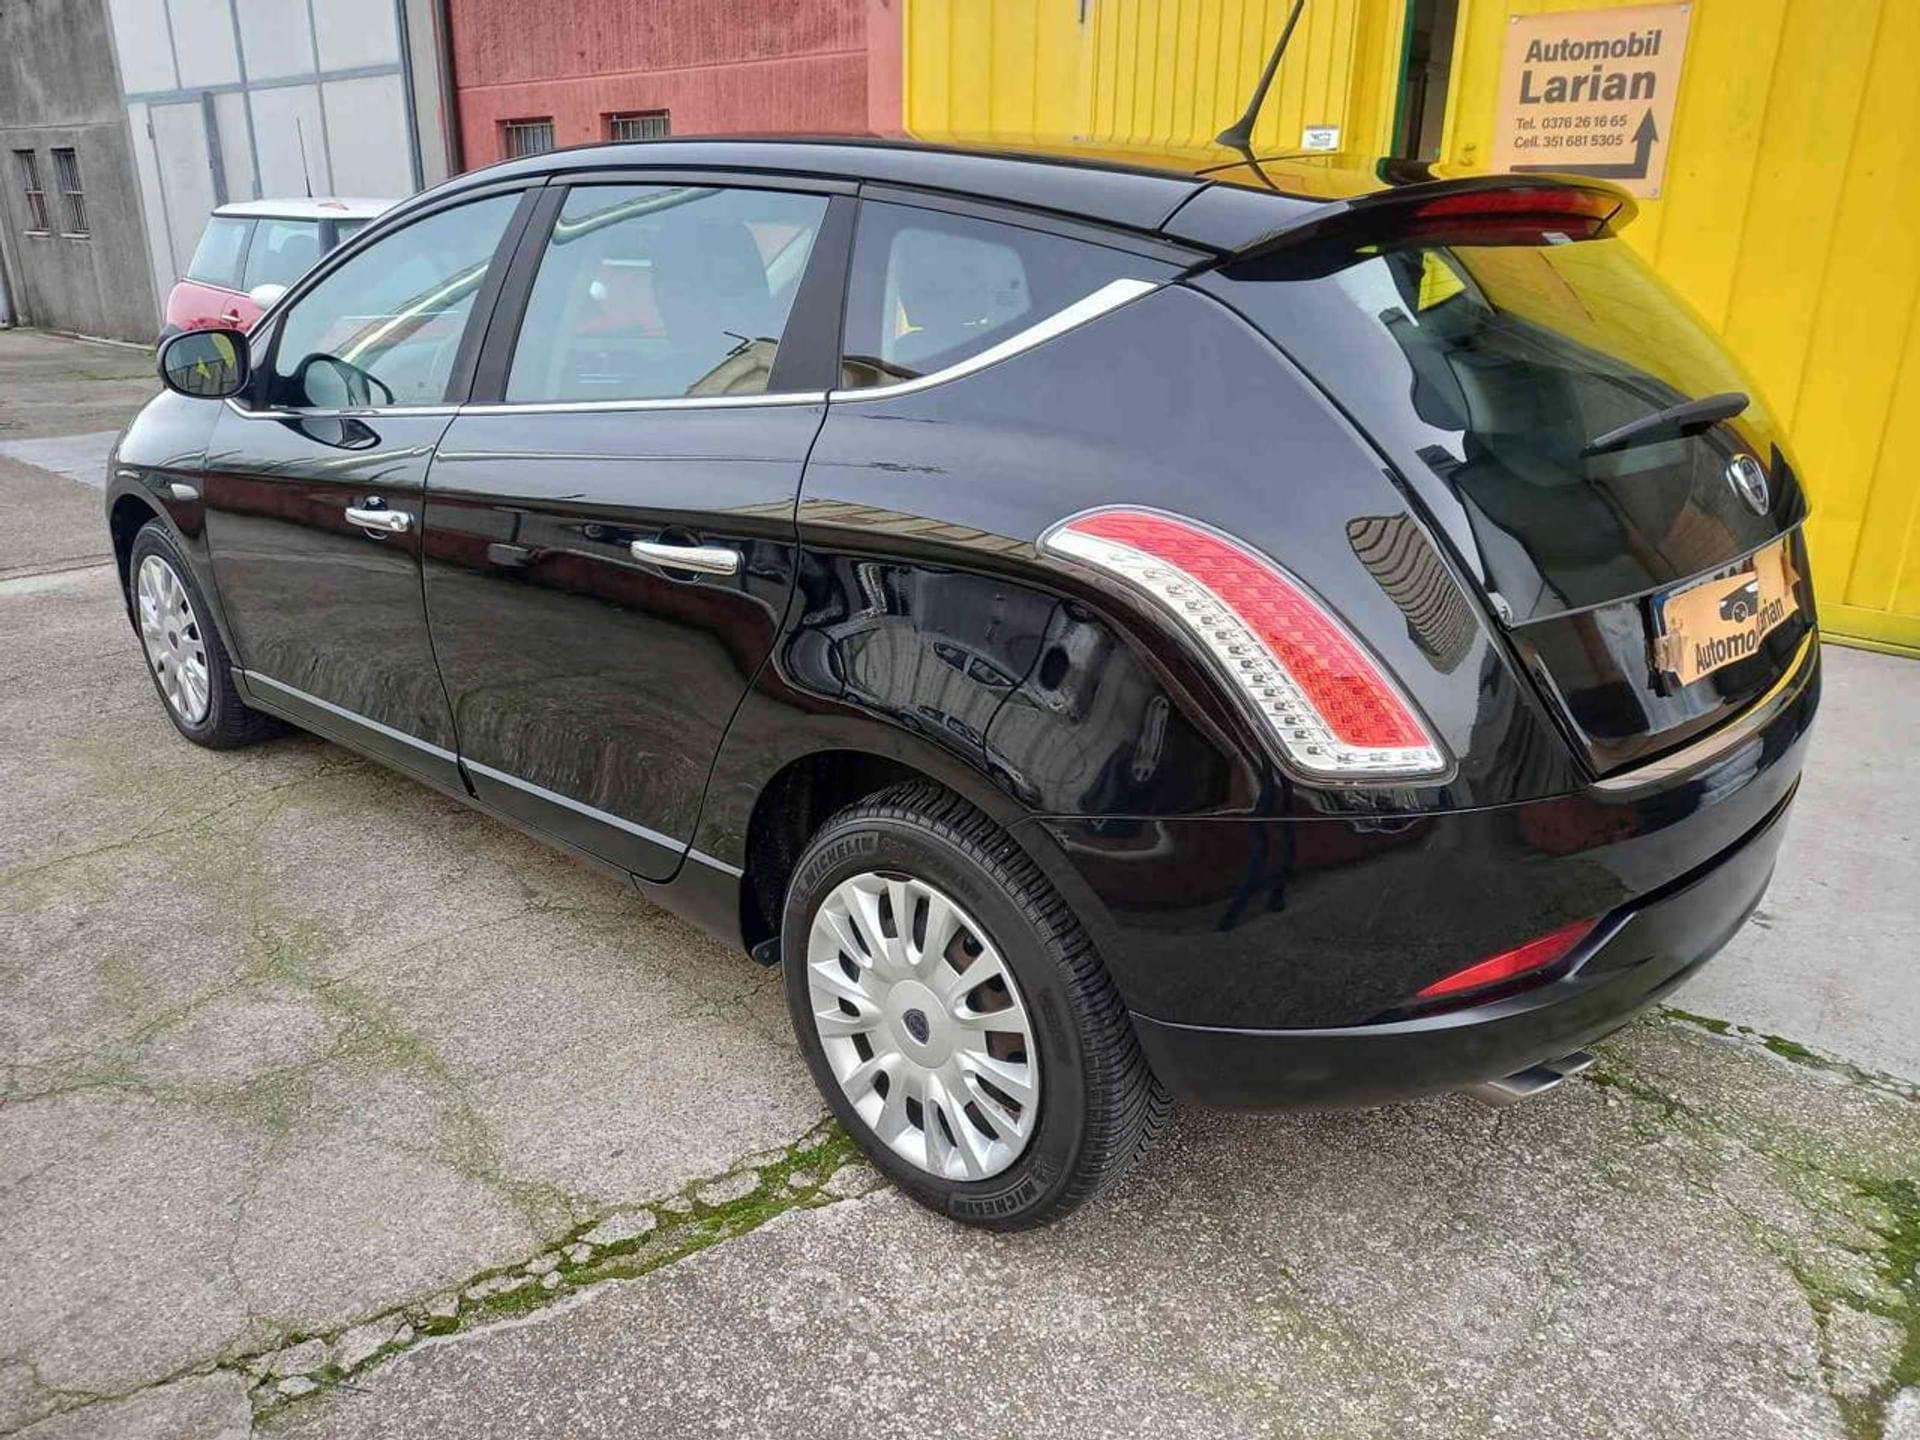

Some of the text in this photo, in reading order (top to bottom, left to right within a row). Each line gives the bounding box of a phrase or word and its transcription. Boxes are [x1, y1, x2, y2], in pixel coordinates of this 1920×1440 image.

[1524, 29, 1662, 63] Automobil
[1519, 65, 1656, 105] Larian
[1517, 117, 1536, 130] Tel.
[1574, 116, 1591, 128] 26
[1609, 114, 1627, 127] 65
[1542, 135, 1564, 147] 351
[1565, 135, 1588, 147] 681
[1590, 134, 1624, 146] 5305
[1695, 629, 1757, 675] Automo
[802, 834, 877, 891] MICHELIN
